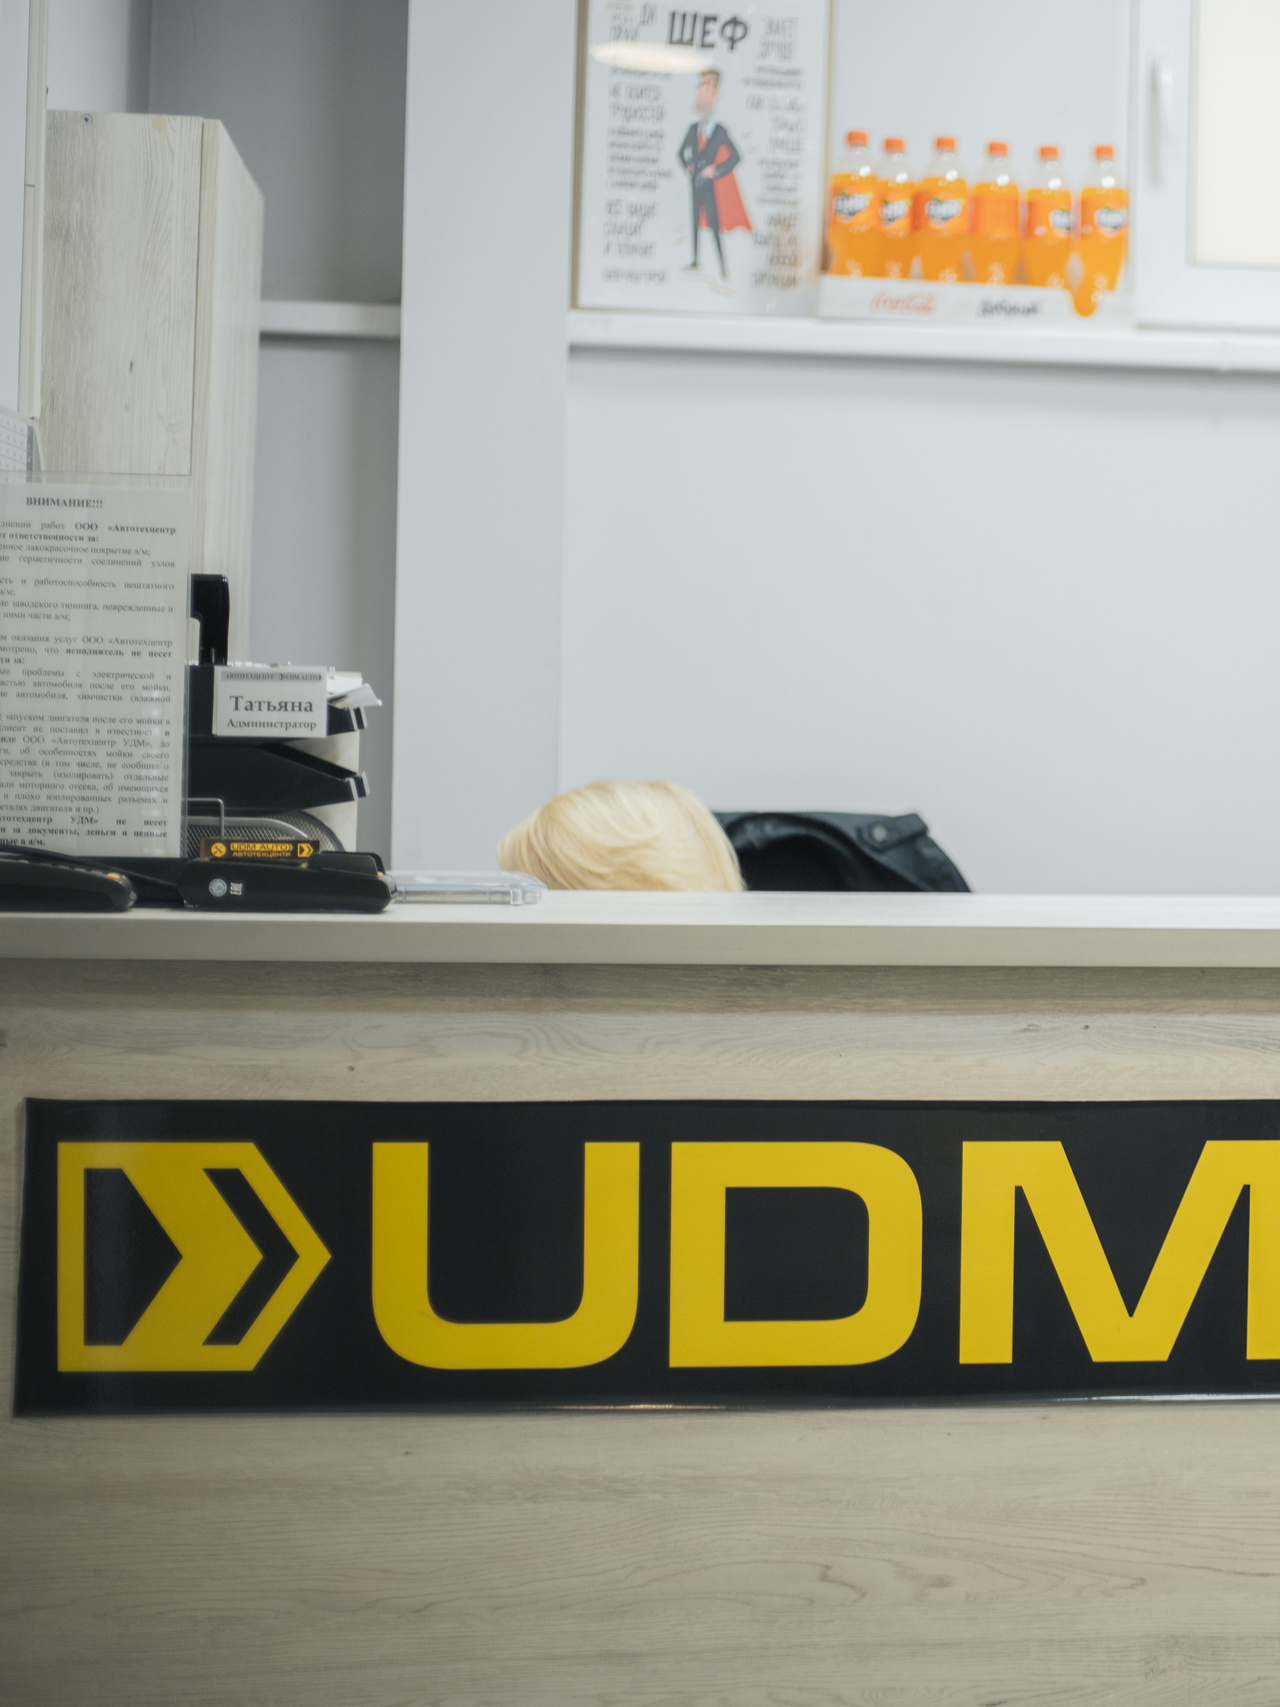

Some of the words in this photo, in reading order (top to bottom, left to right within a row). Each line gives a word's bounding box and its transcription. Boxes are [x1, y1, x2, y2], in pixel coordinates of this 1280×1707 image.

[668, 11, 748, 50] ШЕФ
[26, 497, 103, 508] ВНИМАНИЕ!!!
[9, 534, 84, 542] ответственности
[26, 545, 88, 553] лакокрасочное
[19, 556, 82, 565] герметичности
[92, 558, 141, 566] соединений
[34, 579, 116, 588] работоспособность
[103, 604, 165, 613] поврежденные
[82, 636, 103, 644] ООО
[66, 648, 123, 656] исполнитель
[22, 669, 64, 677] проблемы
[230, 695, 313, 712] Татьяна
[227, 718, 316, 731] Администратор
[39, 749, 96, 757] особенностях
[27, 827, 80, 836] документы,
[232, 843, 256, 851] UDM
